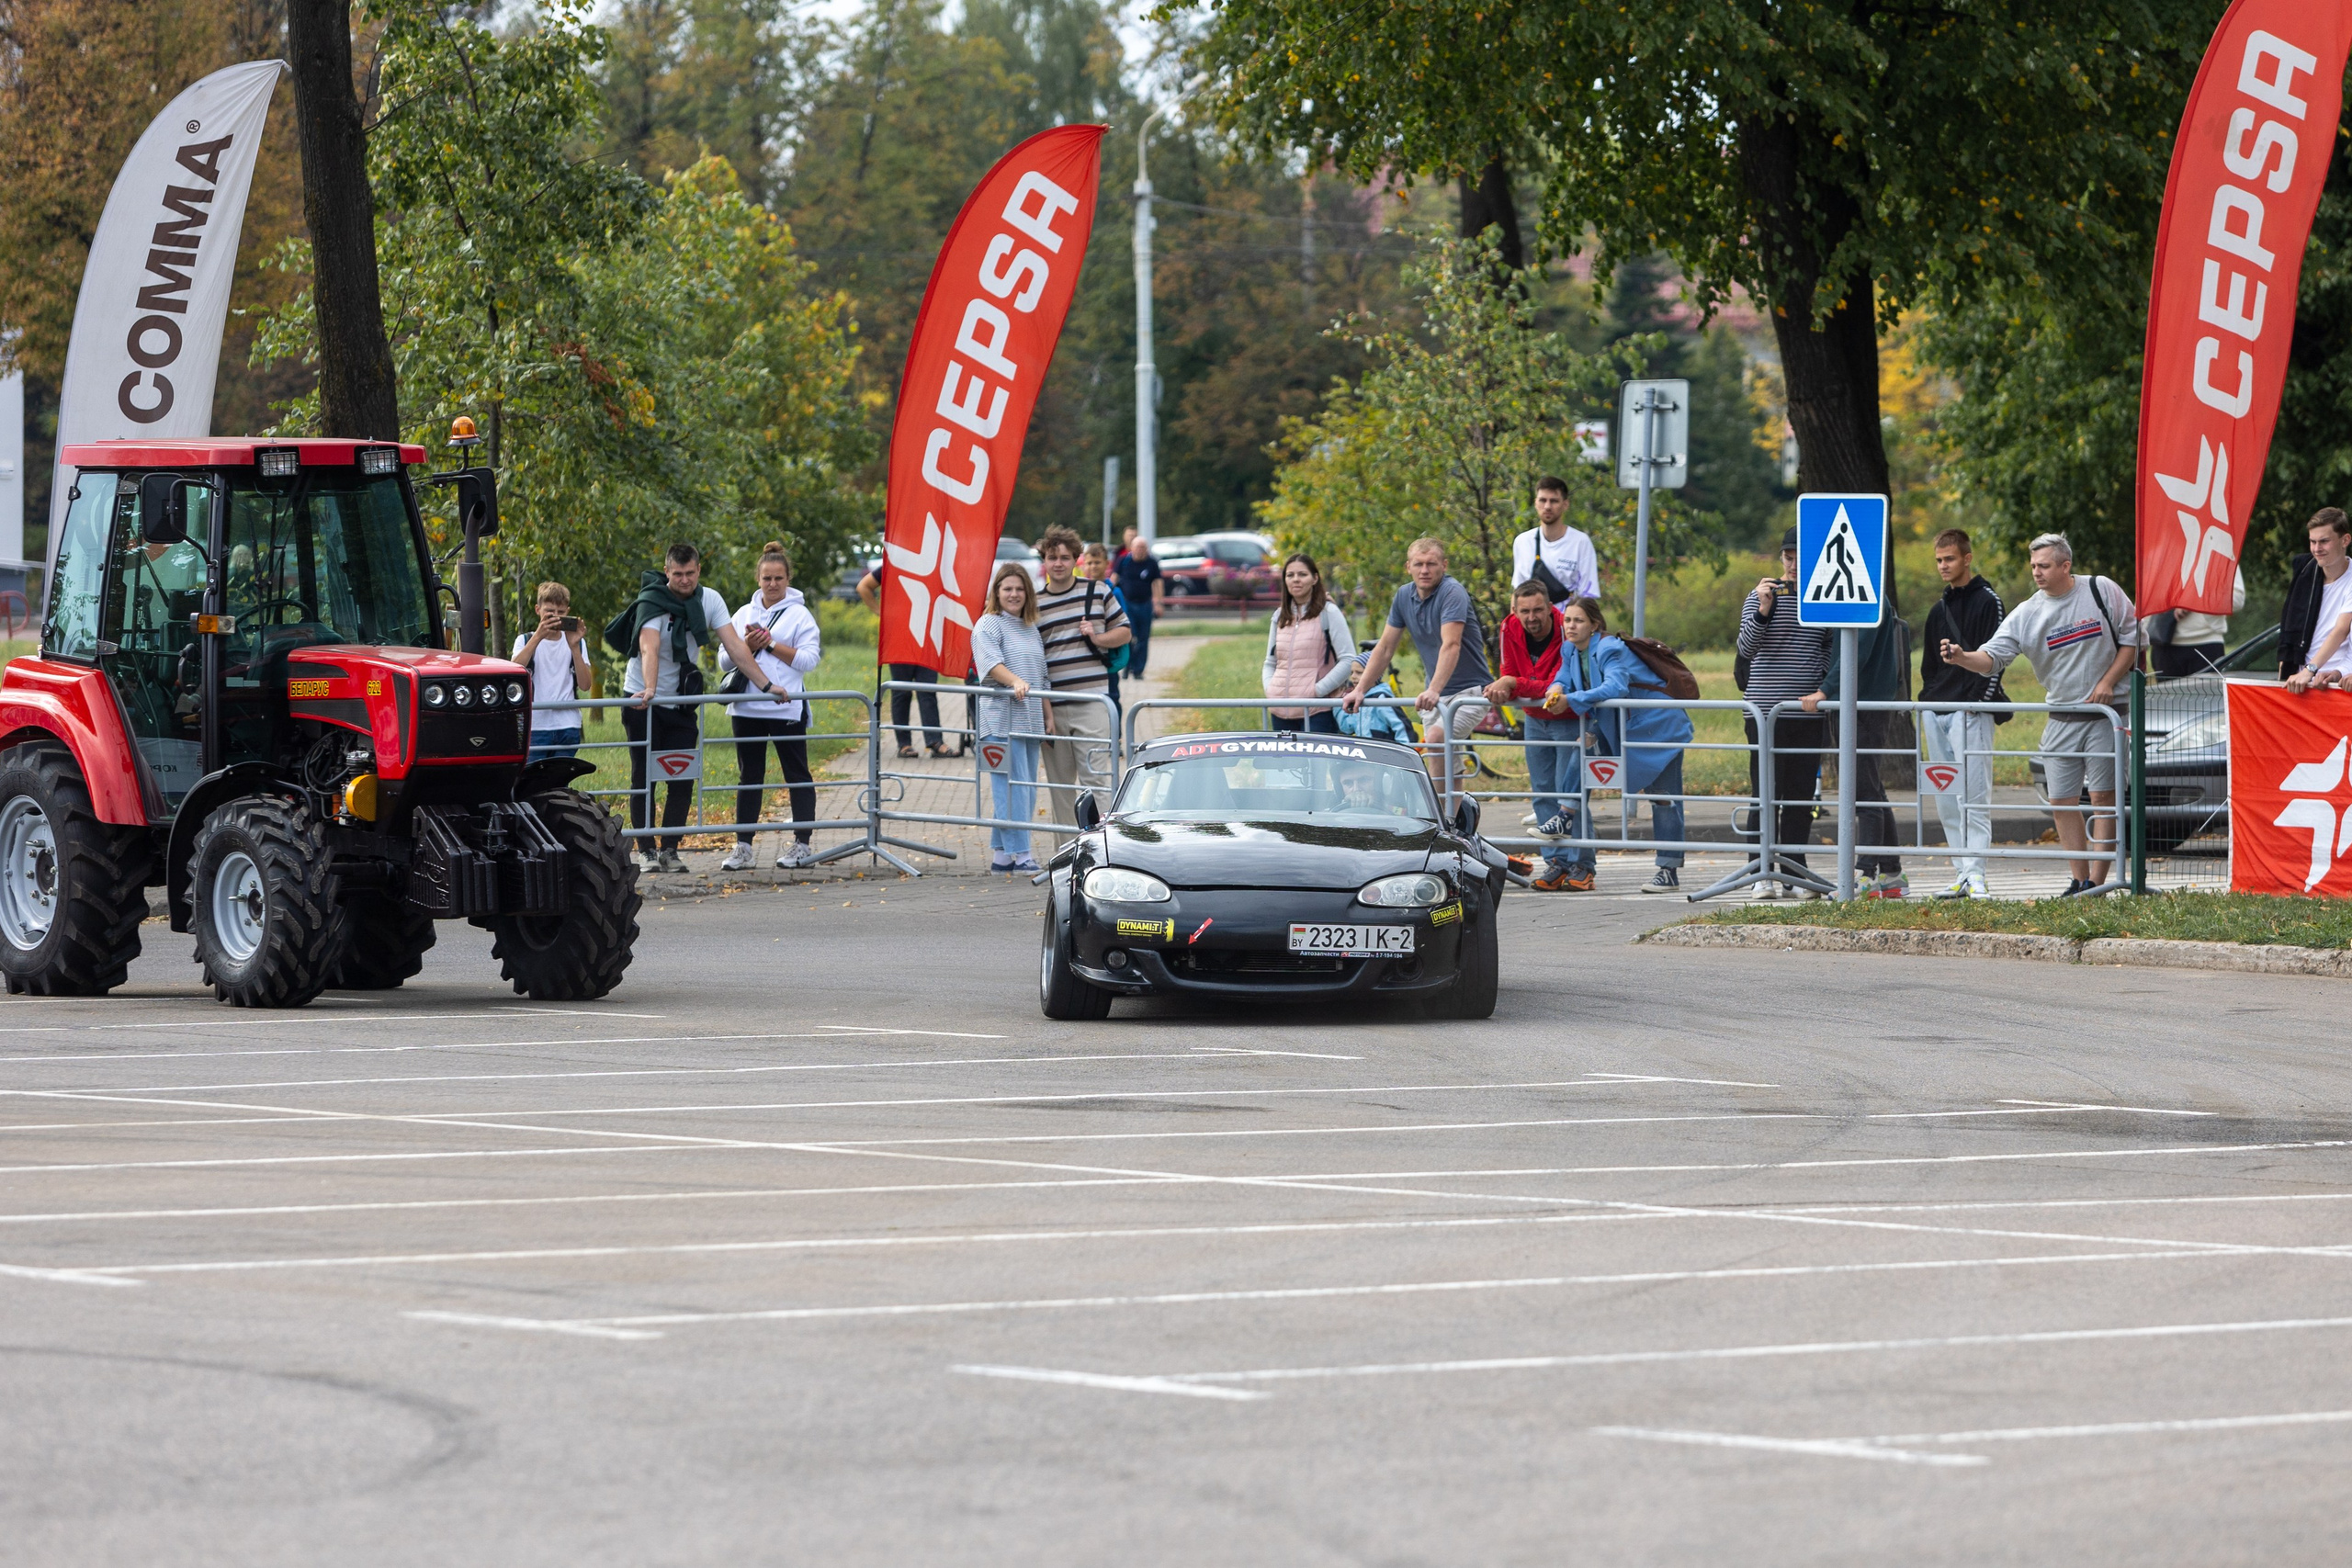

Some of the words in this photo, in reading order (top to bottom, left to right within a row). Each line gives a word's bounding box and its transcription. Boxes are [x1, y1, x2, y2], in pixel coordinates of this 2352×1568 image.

[2193, 29, 2317, 419] CEPSA
[922, 171, 1079, 505] CEPSA
[290, 681, 329, 696] БЕЛАРУС
[367, 681, 381, 695] 622
[1292, 938, 1303, 947] BY
[1308, 927, 1357, 948] 2323
